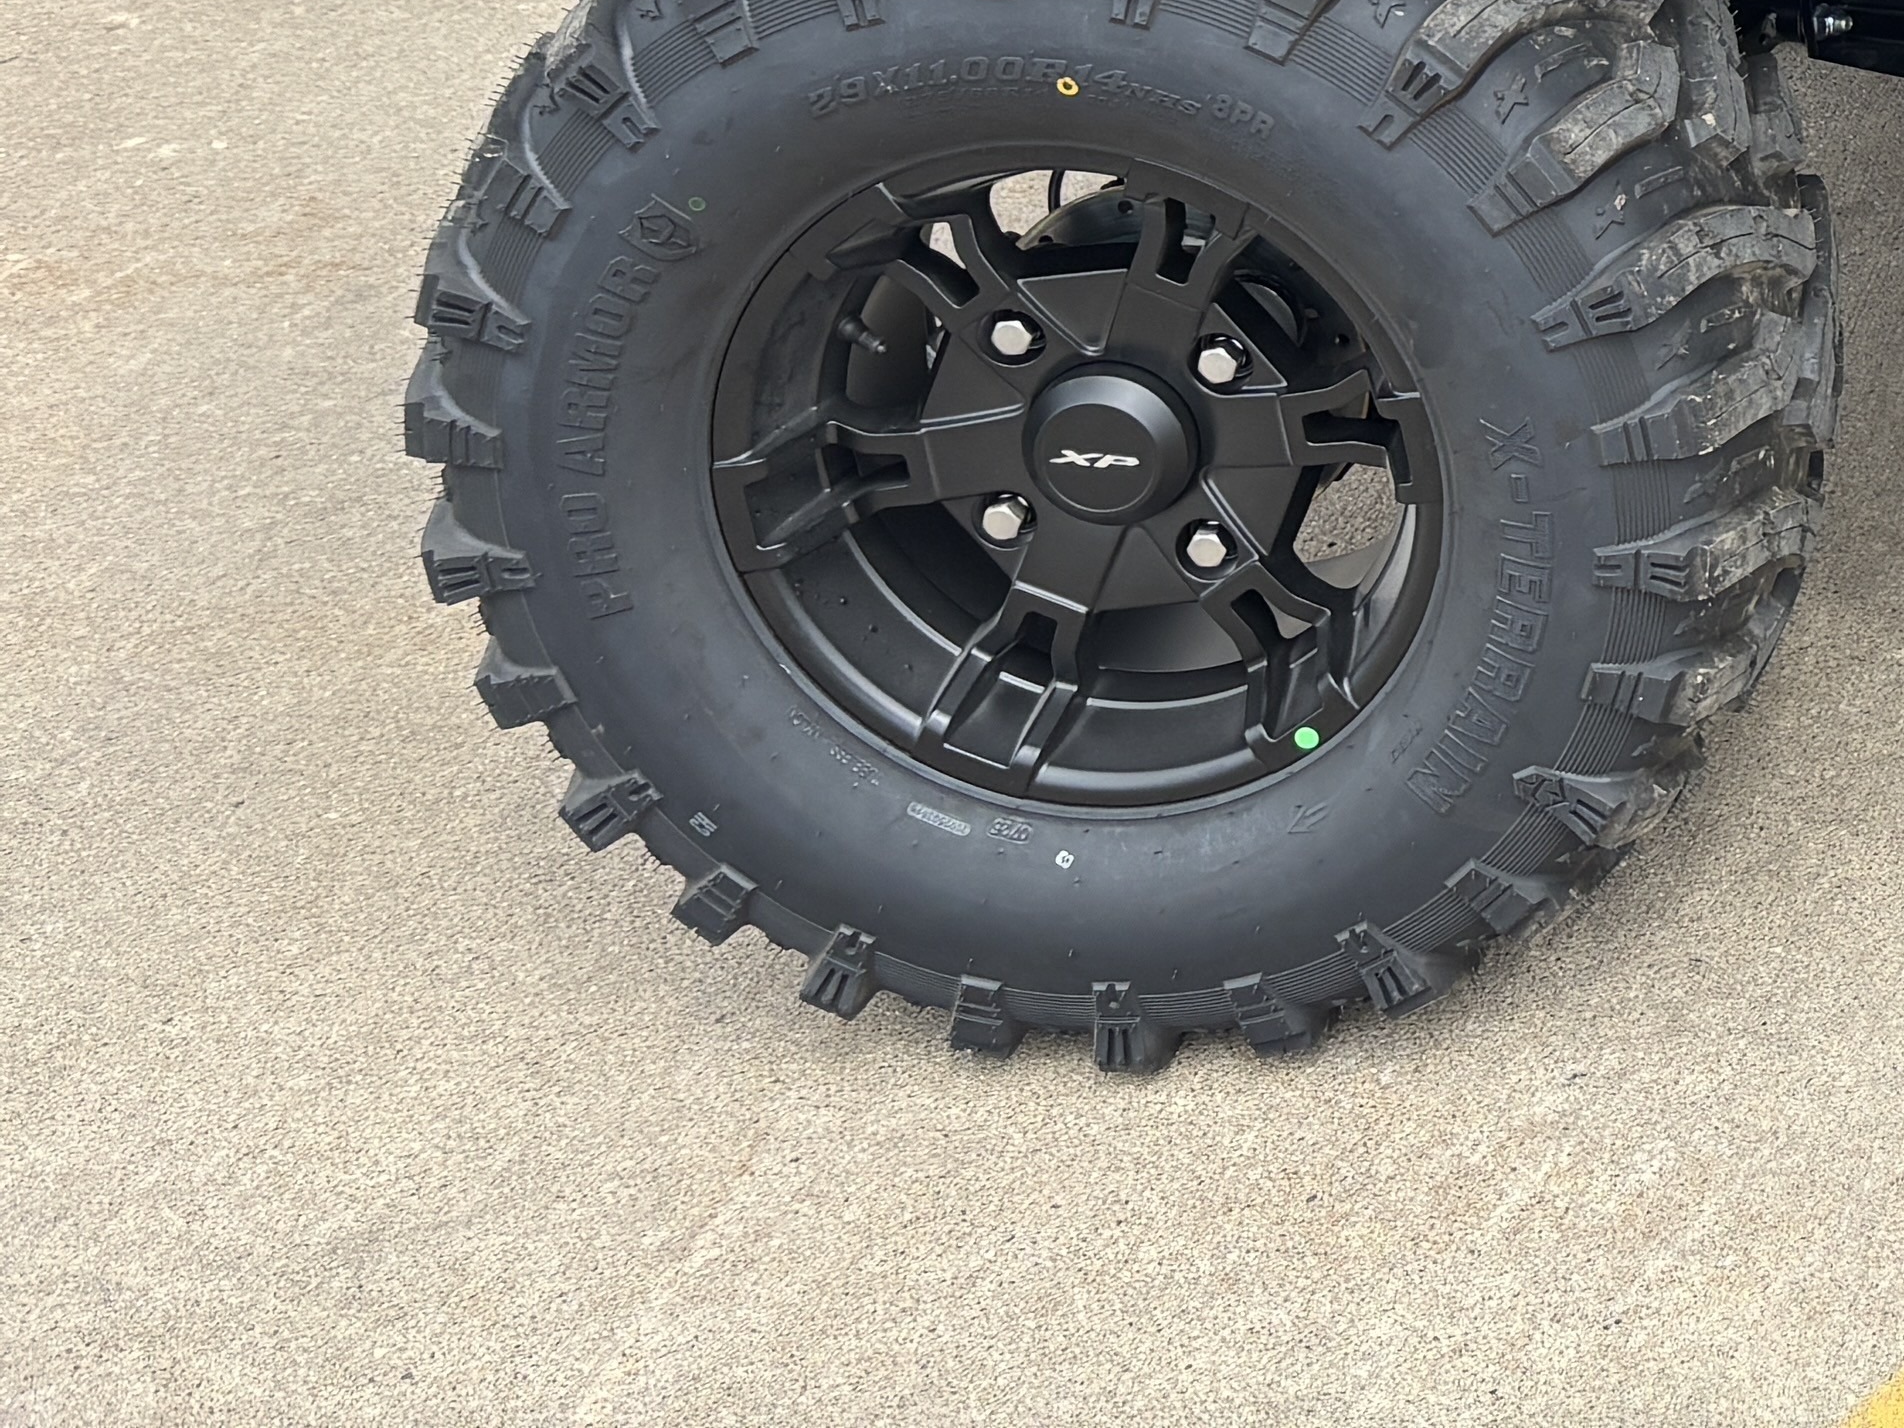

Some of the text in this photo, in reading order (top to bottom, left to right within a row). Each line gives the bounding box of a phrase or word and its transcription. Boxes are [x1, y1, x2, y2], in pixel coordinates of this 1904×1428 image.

[556, 255, 660, 620] PRO ARMOR
[1049, 449, 1140, 468] XP
[1406, 417, 1554, 814] X-TERRAIN
